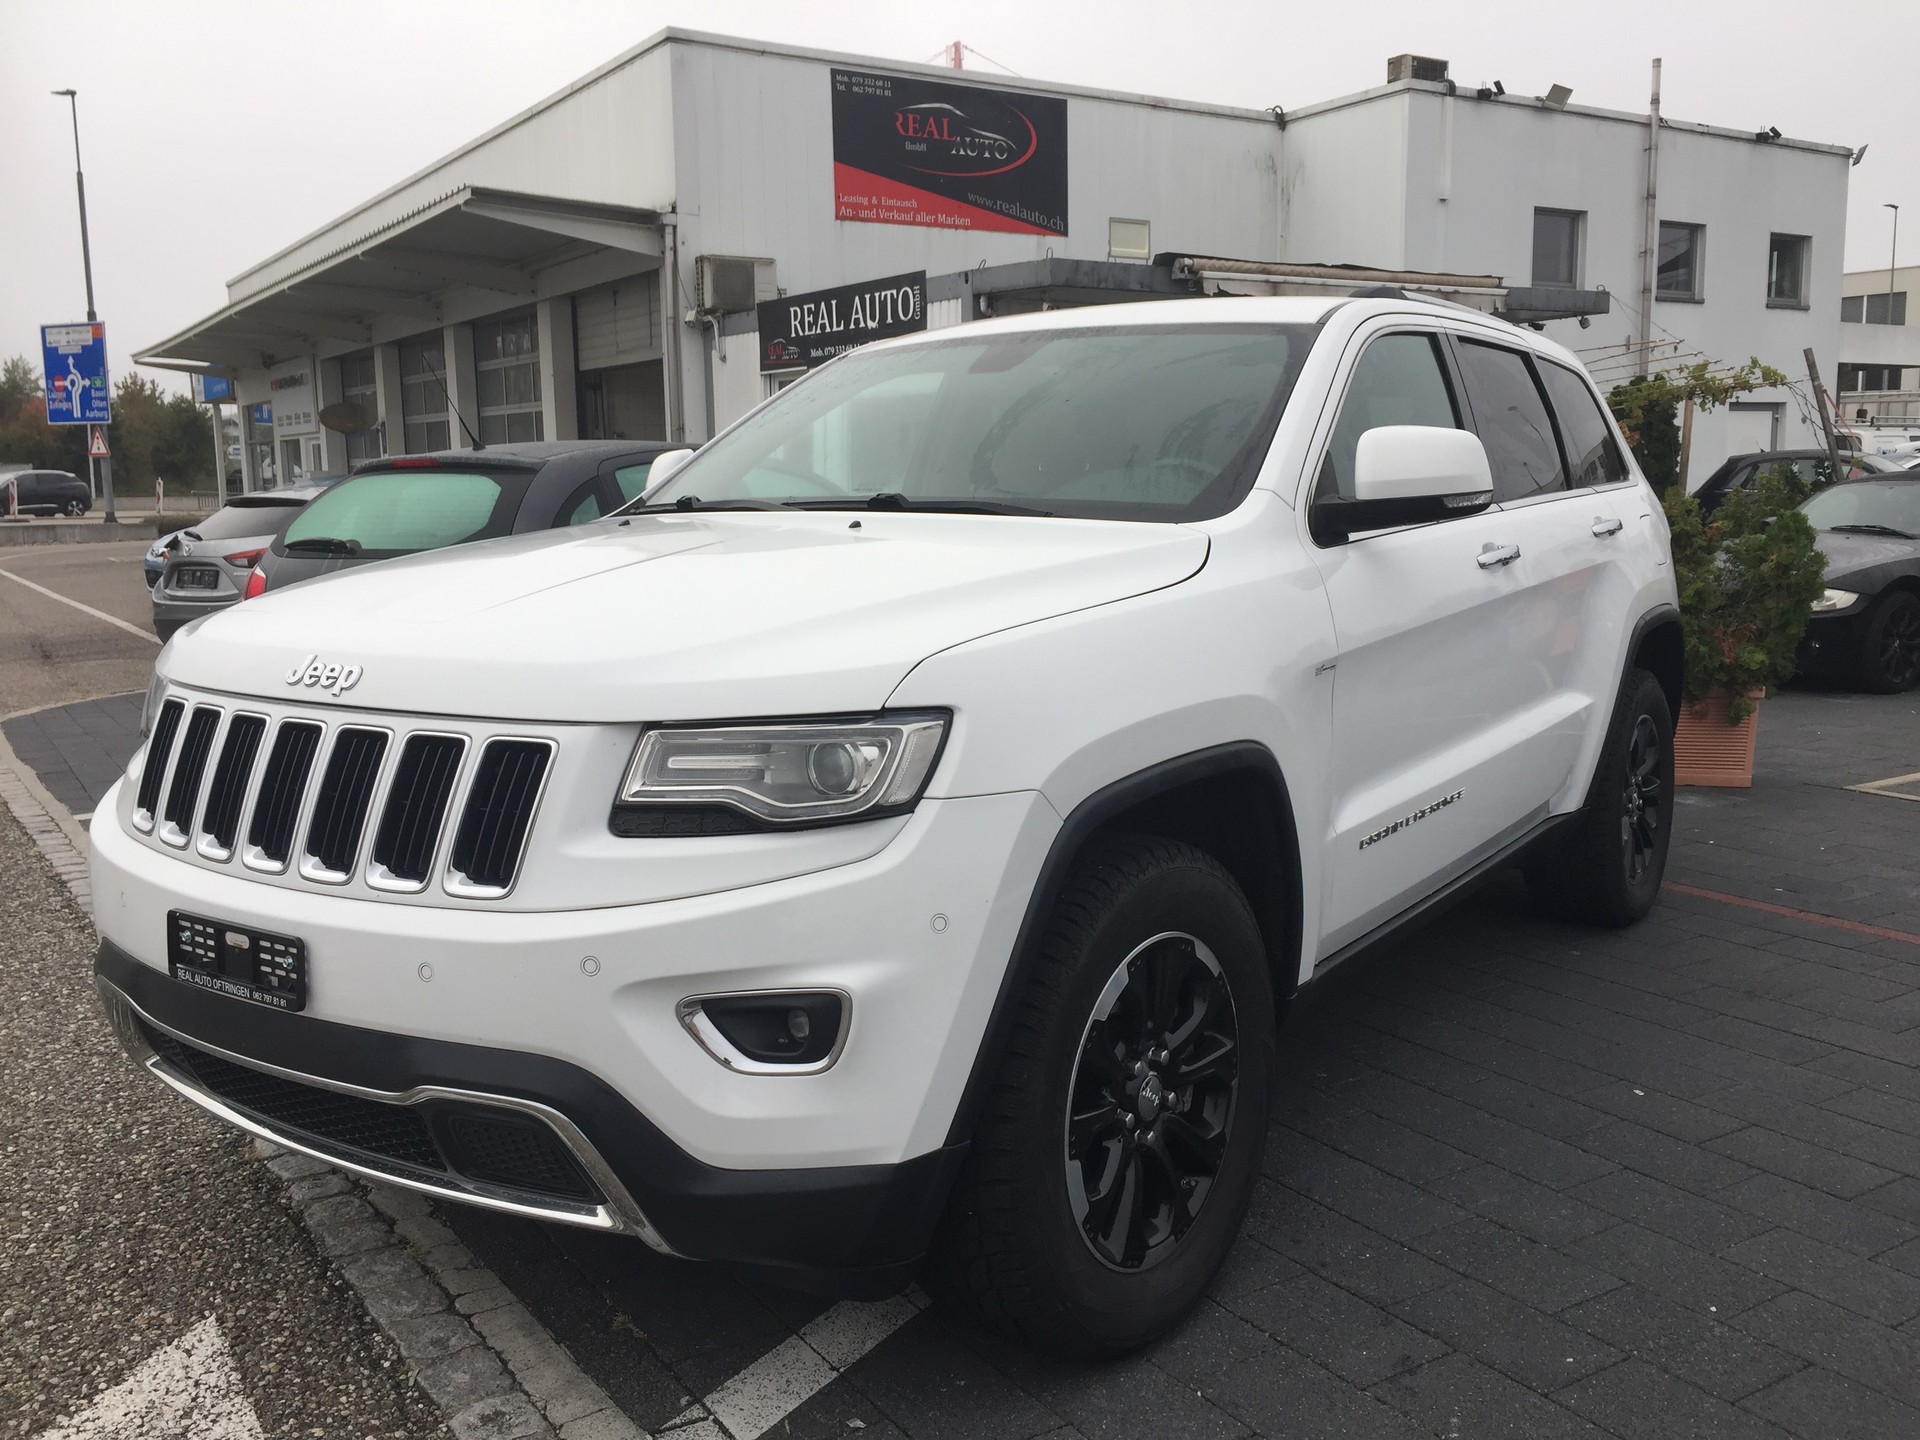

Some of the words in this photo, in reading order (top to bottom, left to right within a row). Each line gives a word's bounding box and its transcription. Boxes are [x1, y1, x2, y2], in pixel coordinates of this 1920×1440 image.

[852, 76, 863, 84] 079
[852, 85, 864, 93] 062
[895, 111, 956, 141] REAL
[905, 141, 927, 151] GmbH
[951, 136, 1008, 160] AUTO
[839, 193, 868, 206] Leasing
[871, 196, 878, 205] &
[840, 206, 856, 217] An-
[858, 208, 876, 219] und
[879, 208, 914, 220] Verkauf
[915, 212, 936, 223] aller
[938, 213, 971, 226] Marken
[967, 192, 1064, 231] www.realauto.ch
[789, 299, 844, 338] REAL
[849, 286, 914, 328] AUTO
[913, 285, 921, 320] GmbH
[824, 346, 835, 356] 079
[285, 654, 364, 697] Jeep
[177, 968, 193, 982] REAL
[194, 975, 212, 987] AUTO
[212, 979, 250, 998] OFTRINGEN
[263, 993, 272, 1003] 797
